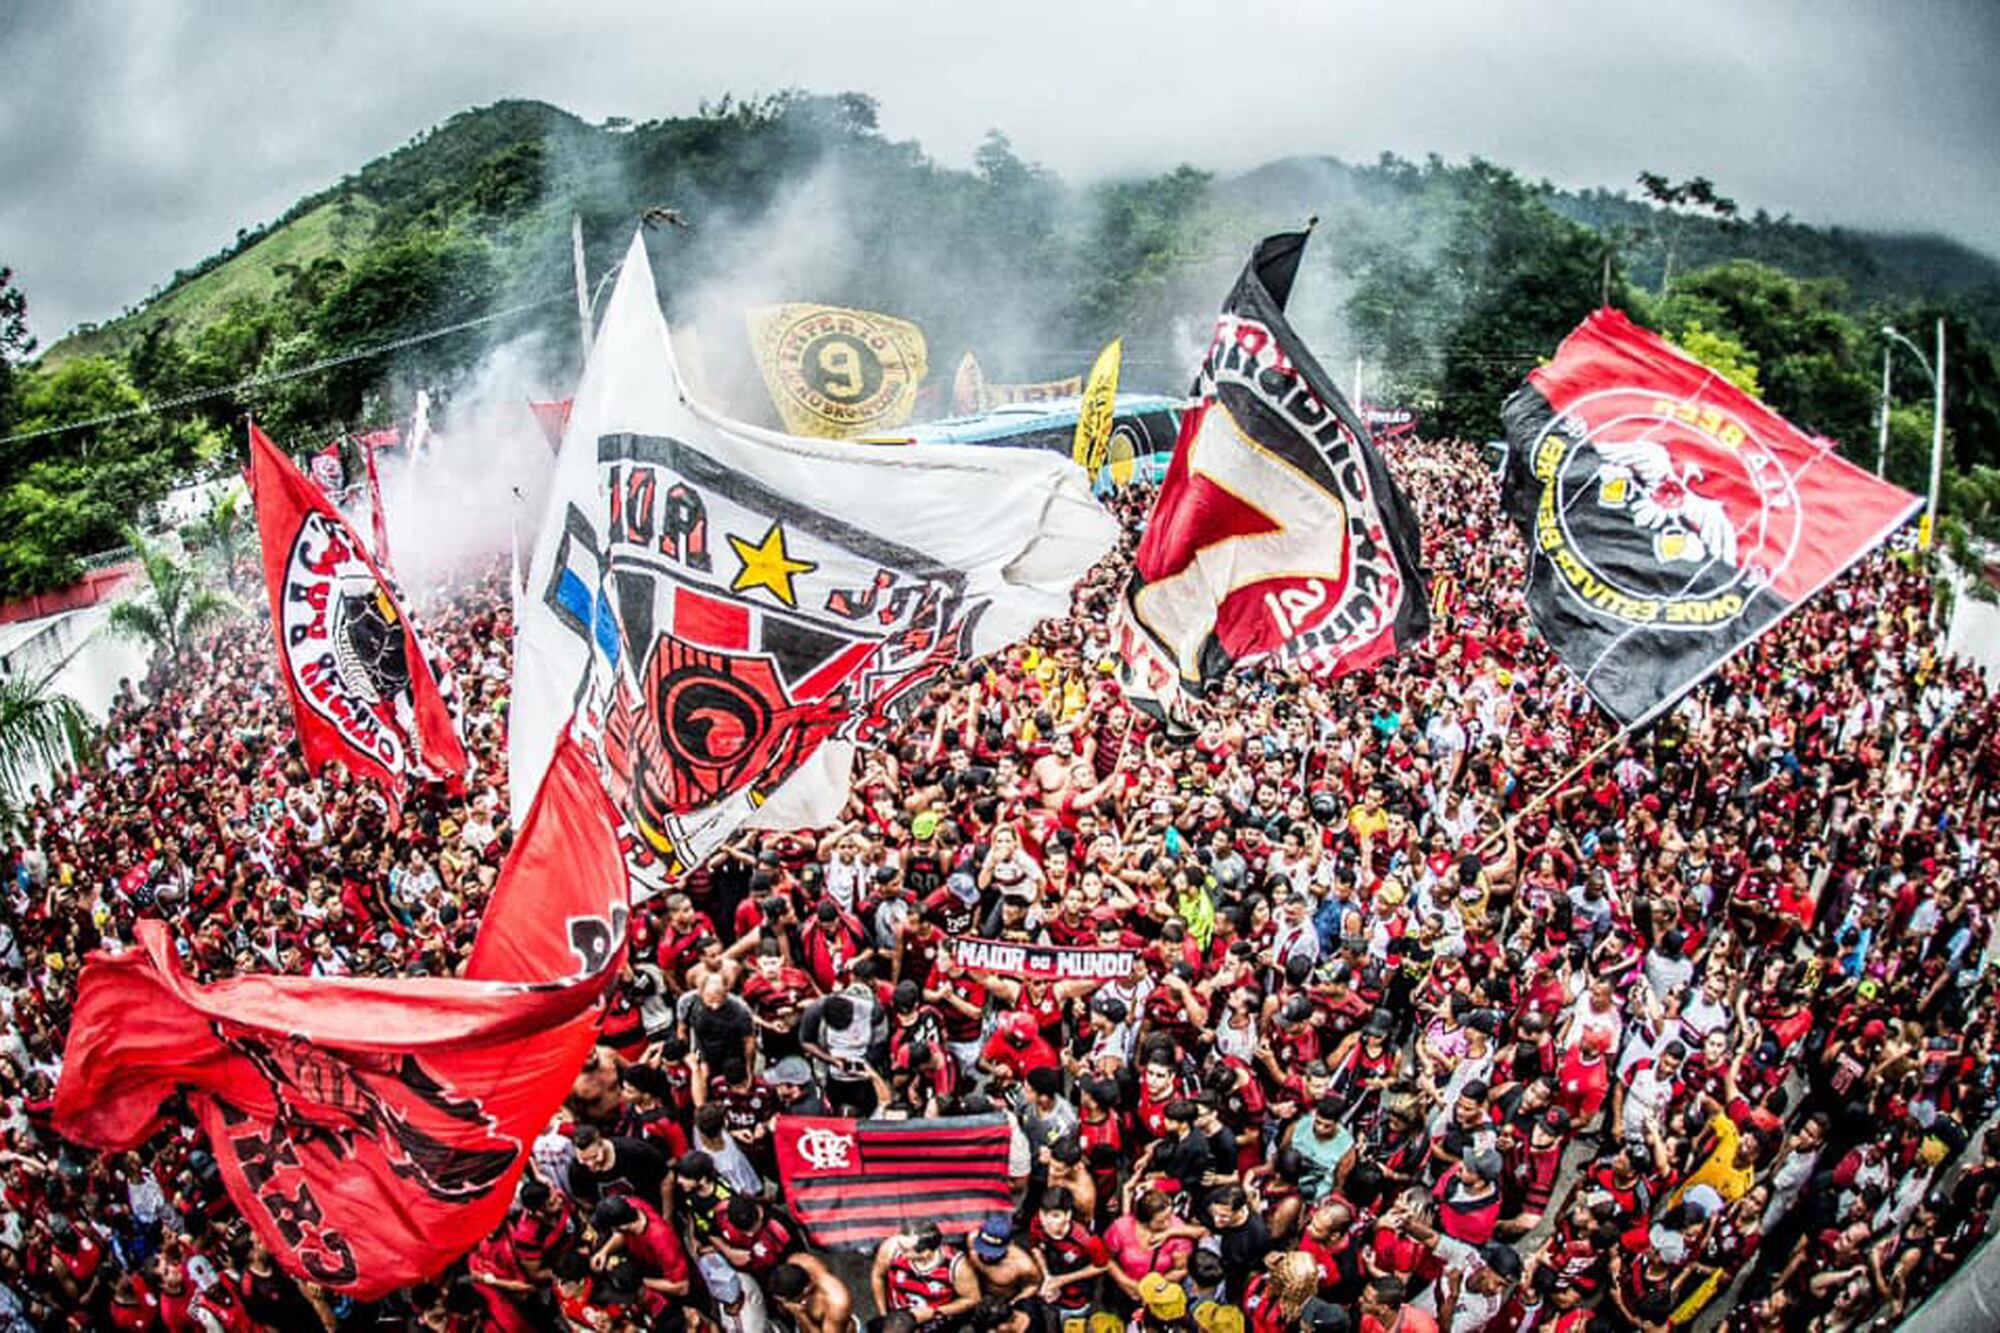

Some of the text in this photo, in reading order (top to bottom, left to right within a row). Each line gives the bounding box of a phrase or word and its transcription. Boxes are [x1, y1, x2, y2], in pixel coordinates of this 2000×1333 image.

[819, 341, 864, 397] 9
[957, 940, 1027, 971] MAIOR
[1056, 951, 1134, 977] MUNDO
